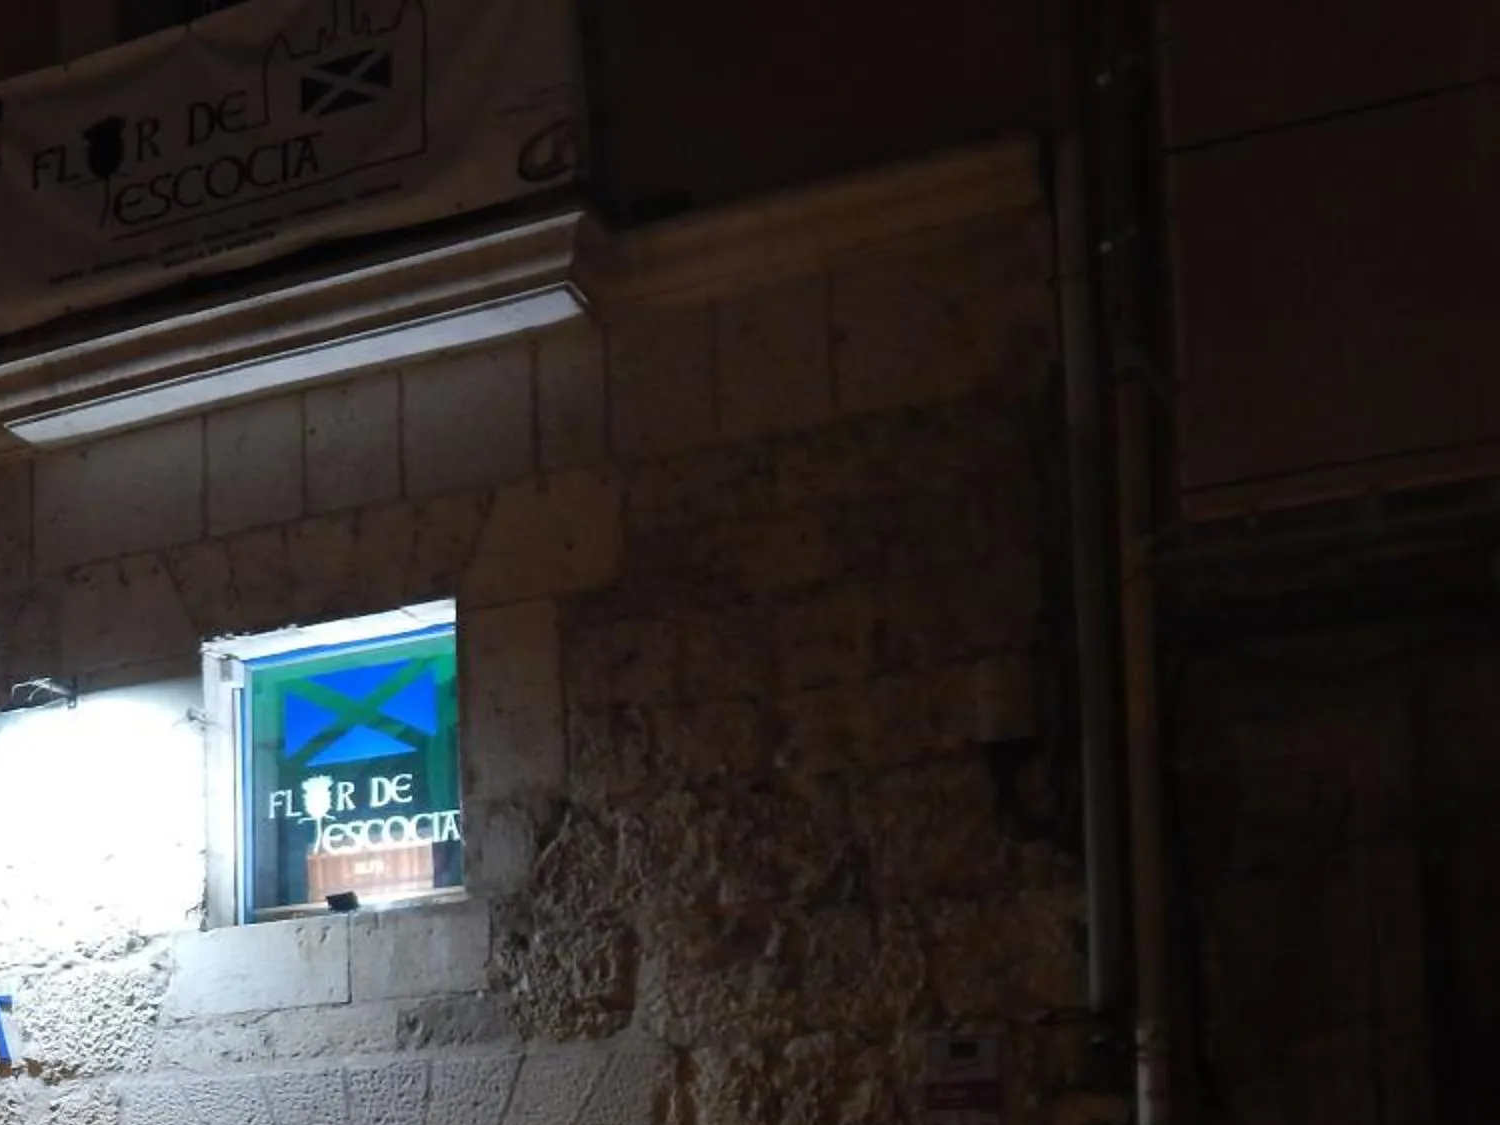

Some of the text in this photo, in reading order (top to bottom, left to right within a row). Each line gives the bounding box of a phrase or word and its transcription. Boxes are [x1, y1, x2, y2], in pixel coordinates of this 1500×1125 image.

[187, 90, 248, 147] DE
[114, 131, 323, 225] ESCOCIA
[369, 773, 413, 808] DE
[323, 809, 462, 852] ESCOCIA
